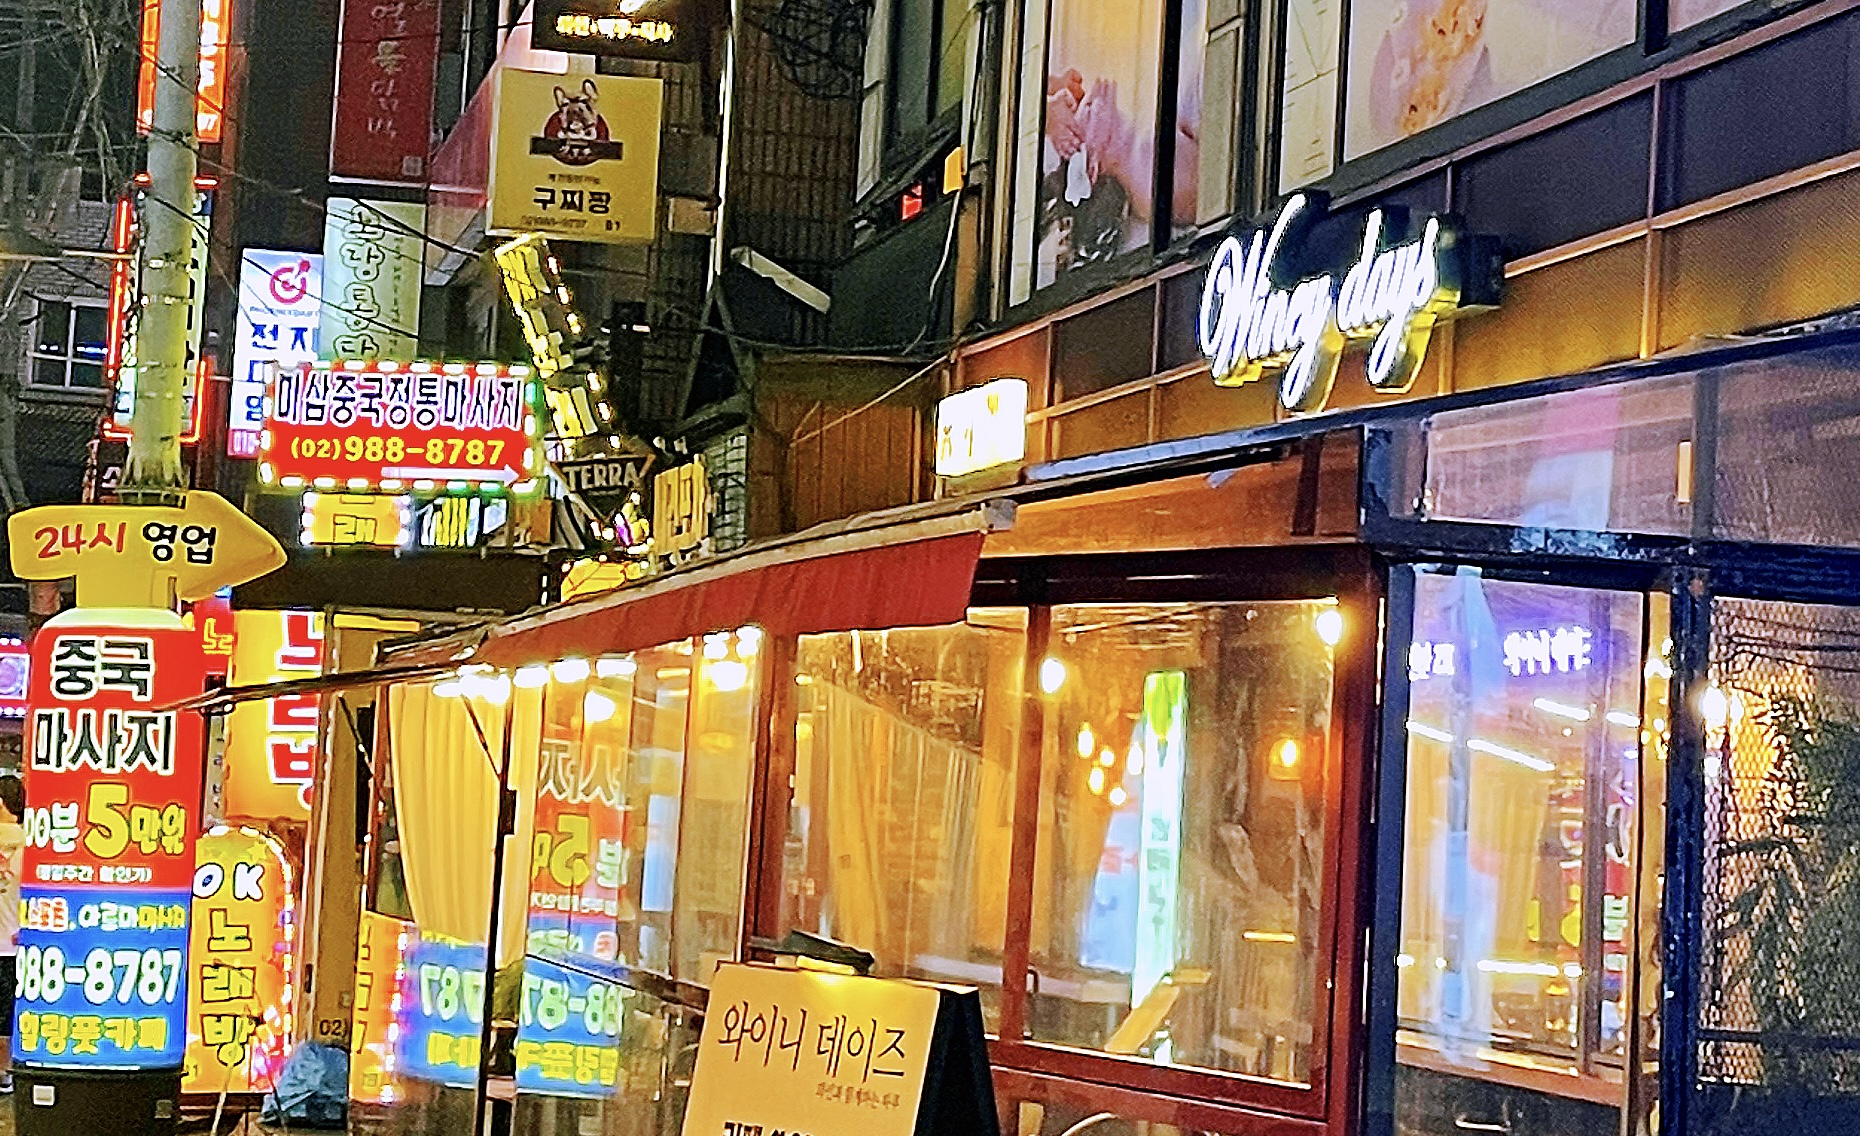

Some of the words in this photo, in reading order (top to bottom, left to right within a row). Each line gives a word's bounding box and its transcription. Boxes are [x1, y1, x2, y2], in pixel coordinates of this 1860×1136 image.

[274, 369, 524, 431] 미삼중국정통마사지
[561, 461, 640, 492] TERRA
[34, 523, 126, 559] 24시
[142, 522, 217, 564] 영업
[50, 636, 156, 701] 중국
[32, 708, 176, 777] 마사지
[193, 862, 264, 901] OK
[718, 1000, 807, 1072] 와이니
[817, 1015, 906, 1083] 데이즈
